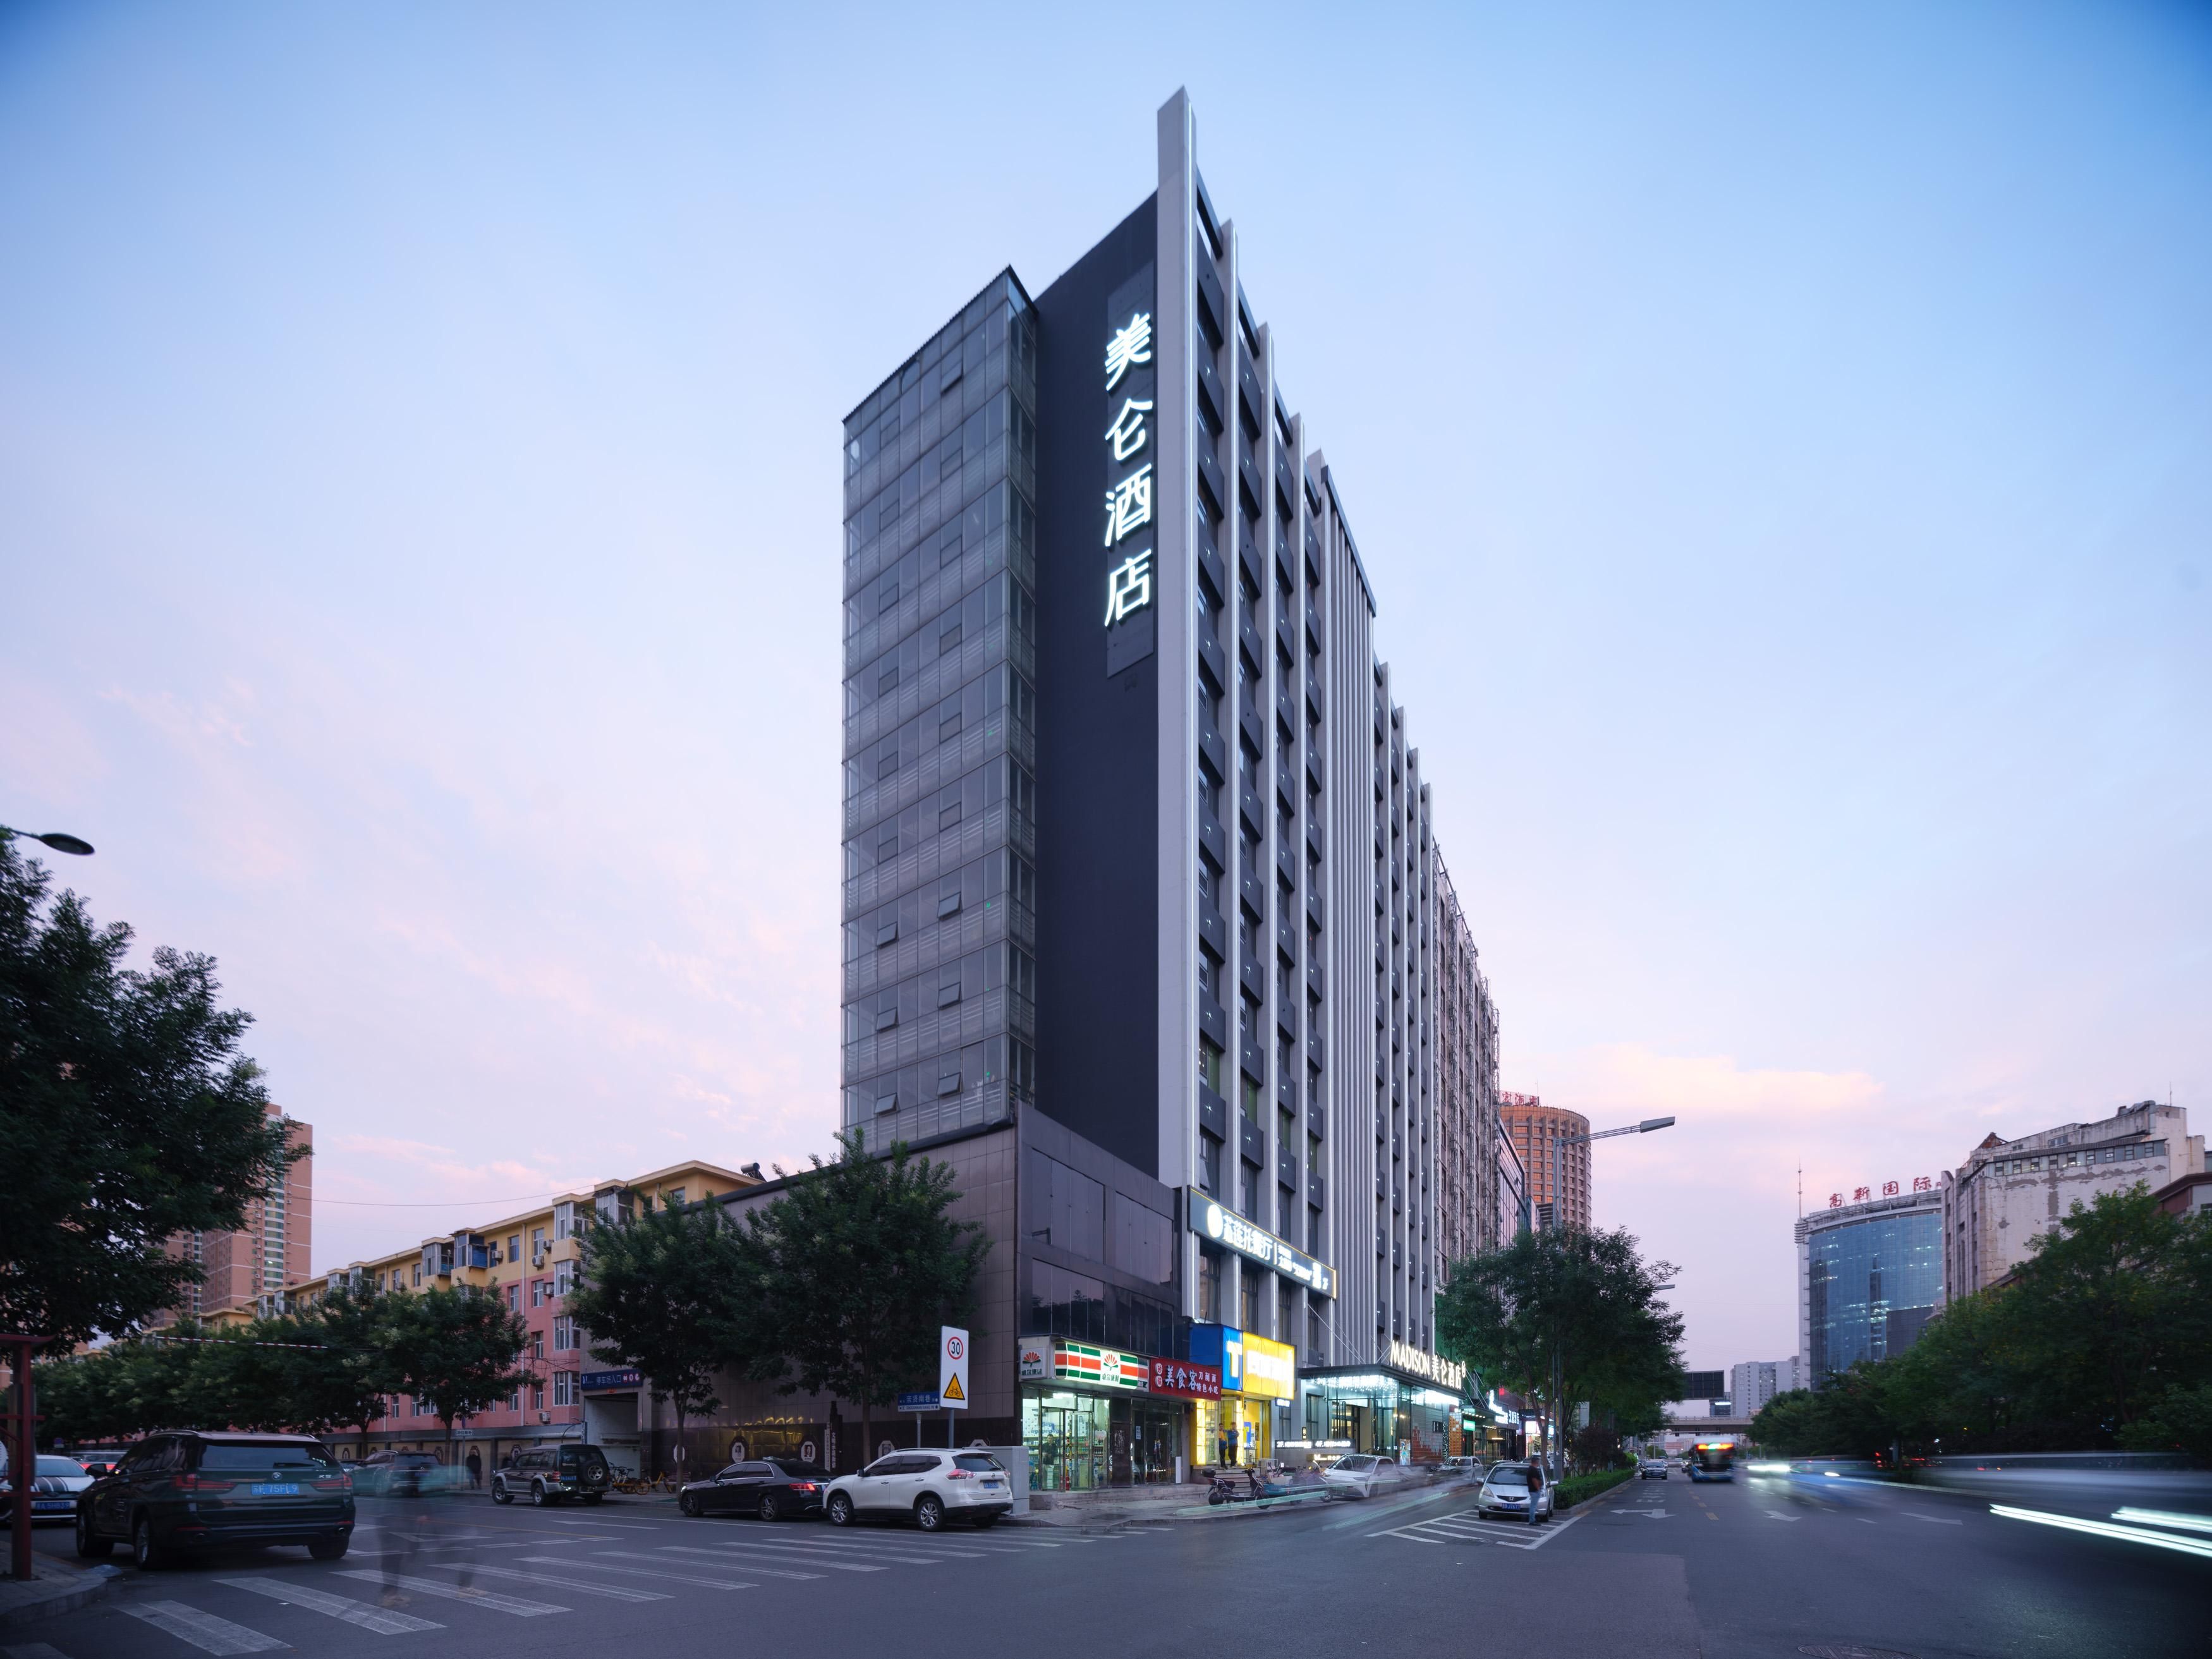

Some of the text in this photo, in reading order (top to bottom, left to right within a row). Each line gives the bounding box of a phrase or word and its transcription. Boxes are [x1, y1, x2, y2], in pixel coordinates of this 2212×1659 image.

[1104, 313, 1153, 627] 美仑酒店
[1829, 1176, 1942, 1208] 高新国际
[951, 1340, 961, 1355] 30
[1165, 1364, 1198, 1390] 美食客
[1198, 1371, 1217, 1383] 刀削面
[1390, 1339, 1462, 1390] MADISON 美仑酒店
[1196, 1382, 1218, 1395] 特色小吃
